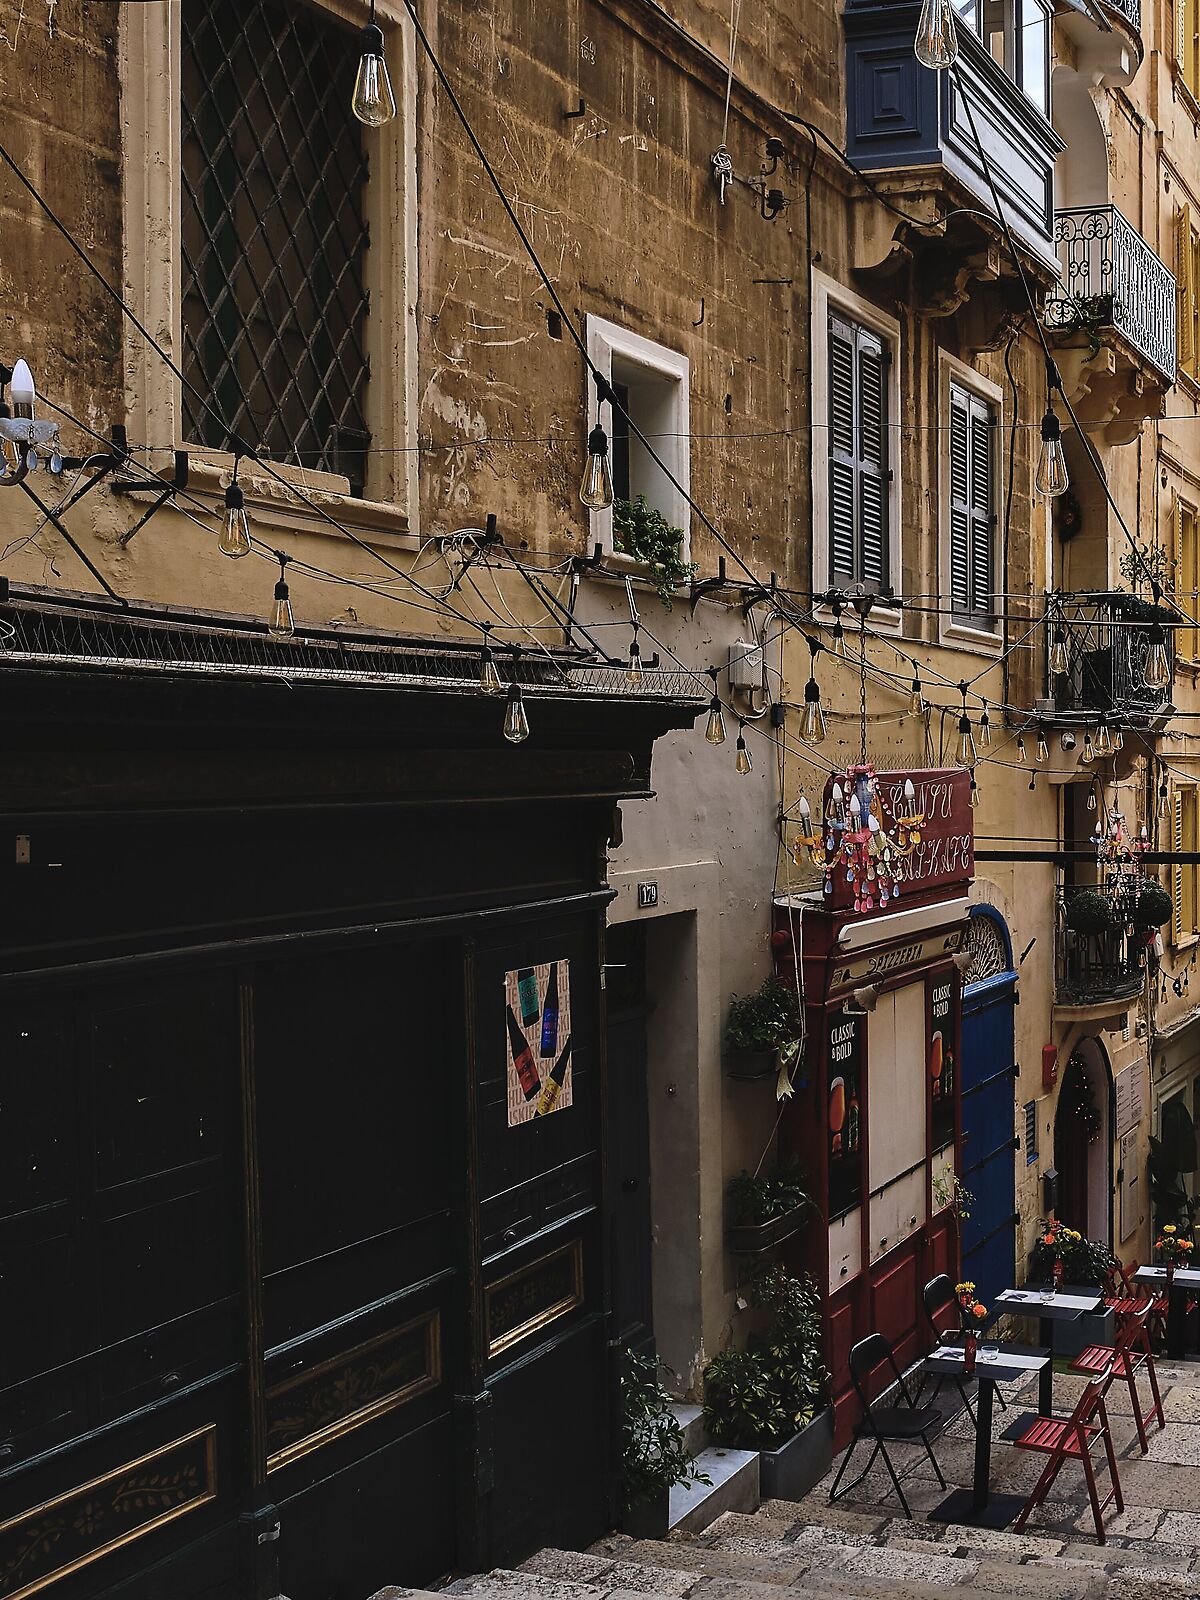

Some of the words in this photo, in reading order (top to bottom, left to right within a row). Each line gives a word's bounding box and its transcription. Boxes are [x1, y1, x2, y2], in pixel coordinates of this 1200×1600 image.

[642, 885, 656, 903] 179
[876, 944, 924, 971] PIZZERIA
[932, 983, 951, 1003] CLASSIC
[936, 1000, 949, 1018] BOLD
[831, 1021, 855, 1045] CLASSIC
[831, 1047, 836, 1059] &
[836, 1041, 852, 1062] BOLD
